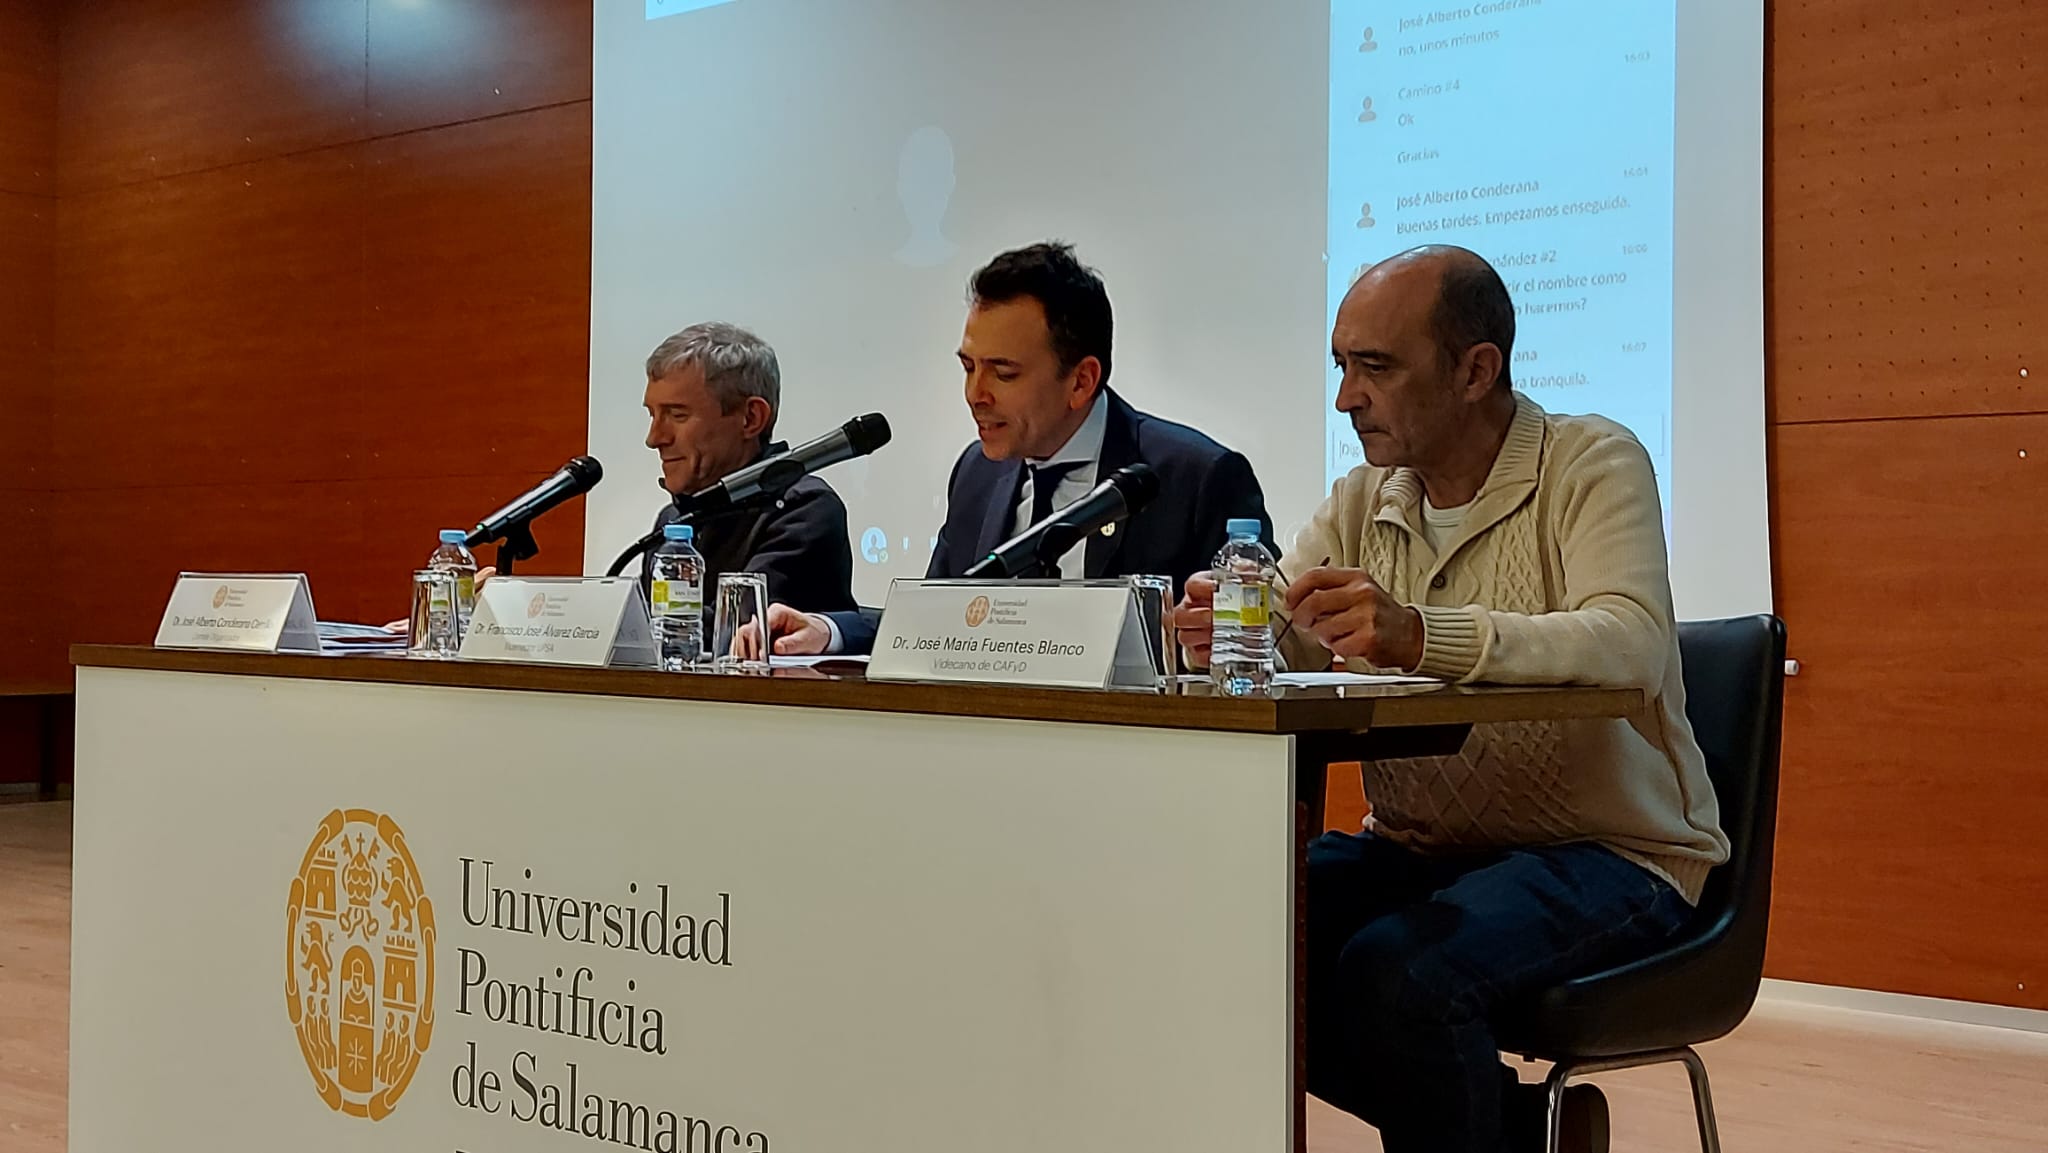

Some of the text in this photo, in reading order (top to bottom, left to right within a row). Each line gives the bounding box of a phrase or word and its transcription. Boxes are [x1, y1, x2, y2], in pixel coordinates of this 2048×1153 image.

[1399, 16, 1424, 33] José
[1425, 7, 1472, 27] Alberto
[1450, 28, 1501, 48] minutos
[1398, 80, 1442, 100] Camino
[1396, 179, 1540, 211] José Alberto Conderana
[1396, 195, 1632, 235] Buenas tardes. Empezamos enseguida.
[1537, 273, 1588, 291] nombre
[1590, 270, 1627, 286] como
[1525, 298, 1588, 315] hacemos?
[1530, 372, 1590, 389] tranquila.
[892, 636, 1085, 656] Dr. José María Fuentes Blanco
[979, 661, 991, 671] de
[459, 857, 733, 966] Universidad
[455, 947, 668, 1055] Pontificia
[452, 1041, 771, 1153] de Salamanca
